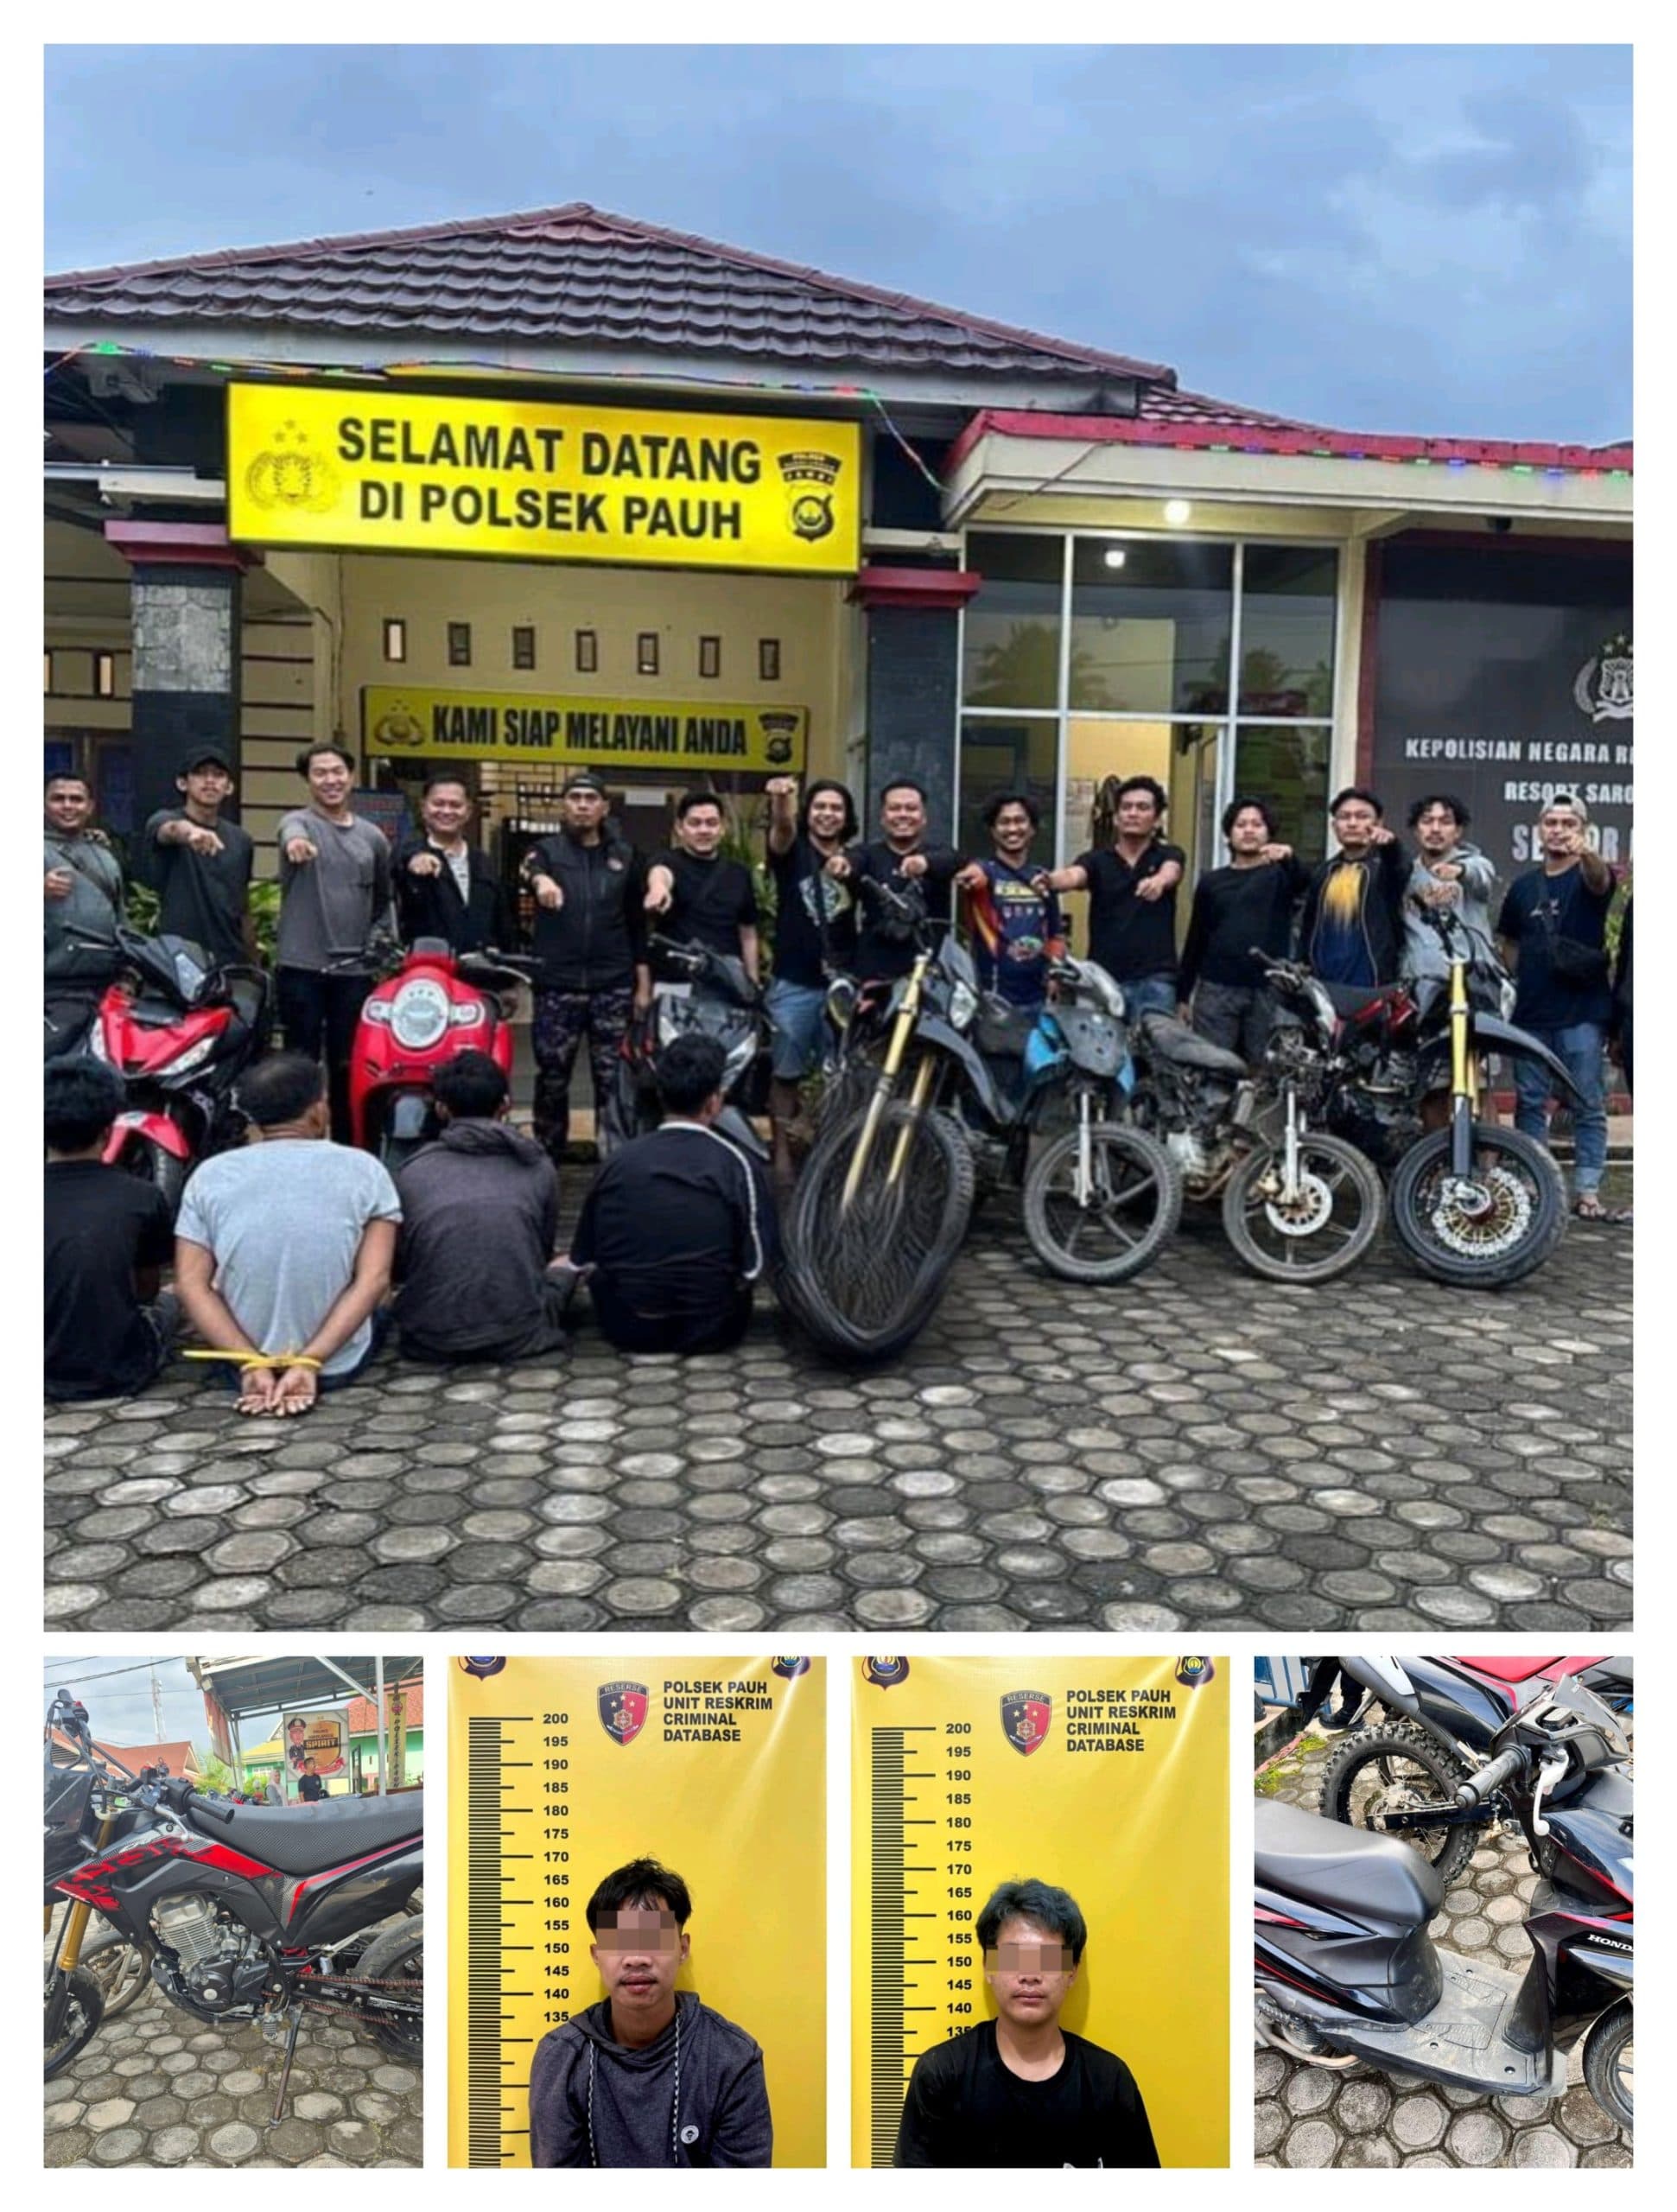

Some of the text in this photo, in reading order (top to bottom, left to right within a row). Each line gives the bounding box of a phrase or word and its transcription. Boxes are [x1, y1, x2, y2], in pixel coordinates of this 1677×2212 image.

[338, 416, 761, 484] SELAMAT DATANG
[360, 480, 741, 539] DI POLSEK PAUH
[432, 704, 748, 757] KAMI SIAP MELAYANI ANDA
[1405, 738, 1521, 760] KEPOLISIAN
[1528, 741, 1610, 763] NEGARA
[1503, 781, 1581, 802] RESORT
[1512, 823, 1620, 862] SEOR
[664, 1681, 767, 1694] POLSEK PAUH
[1066, 1689, 1171, 1703] POLSEK PAUH
[663, 1696, 773, 1710] UNIT RESKRIM
[1066, 1706, 1177, 1719] UNIT RESKRIM
[543, 1713, 569, 1725] 200
[663, 1713, 738, 1726] CRIMINAL
[946, 1722, 972, 1734] 200
[1066, 1721, 1141, 1736] CRIMINAL
[543, 1735, 569, 1747] 195
[663, 1728, 741, 1742] DATABASE
[306, 1738, 336, 1748] SPIRIT
[1066, 1738, 1145, 1752] DATABASE
[946, 1745, 972, 1758] 195
[543, 1758, 569, 1770] 190
[946, 1769, 972, 1781] 190
[543, 1782, 569, 1794] 185
[946, 1793, 972, 1805] 185
[543, 1804, 569, 1816] 180
[946, 1816, 972, 1828] 180
[543, 1827, 569, 1840] 175
[946, 1840, 972, 1852] 175
[543, 1851, 569, 1863] 170
[946, 1863, 972, 1875] 170
[543, 1873, 569, 1885] 165
[946, 1886, 972, 1898] 165
[543, 1897, 569, 1909] 160
[946, 1910, 972, 1922] 160
[543, 1919, 569, 1931] 155
[946, 1933, 972, 1945] 155
[1587, 1934, 1633, 1952] HOND
[543, 1942, 569, 1955] 150
[946, 1955, 972, 1967] 150
[543, 1965, 569, 1977] 145
[946, 1979, 972, 1991] 145
[543, 1987, 569, 1999] 140
[946, 2002, 972, 2014] 140
[543, 2011, 569, 2023] 135
